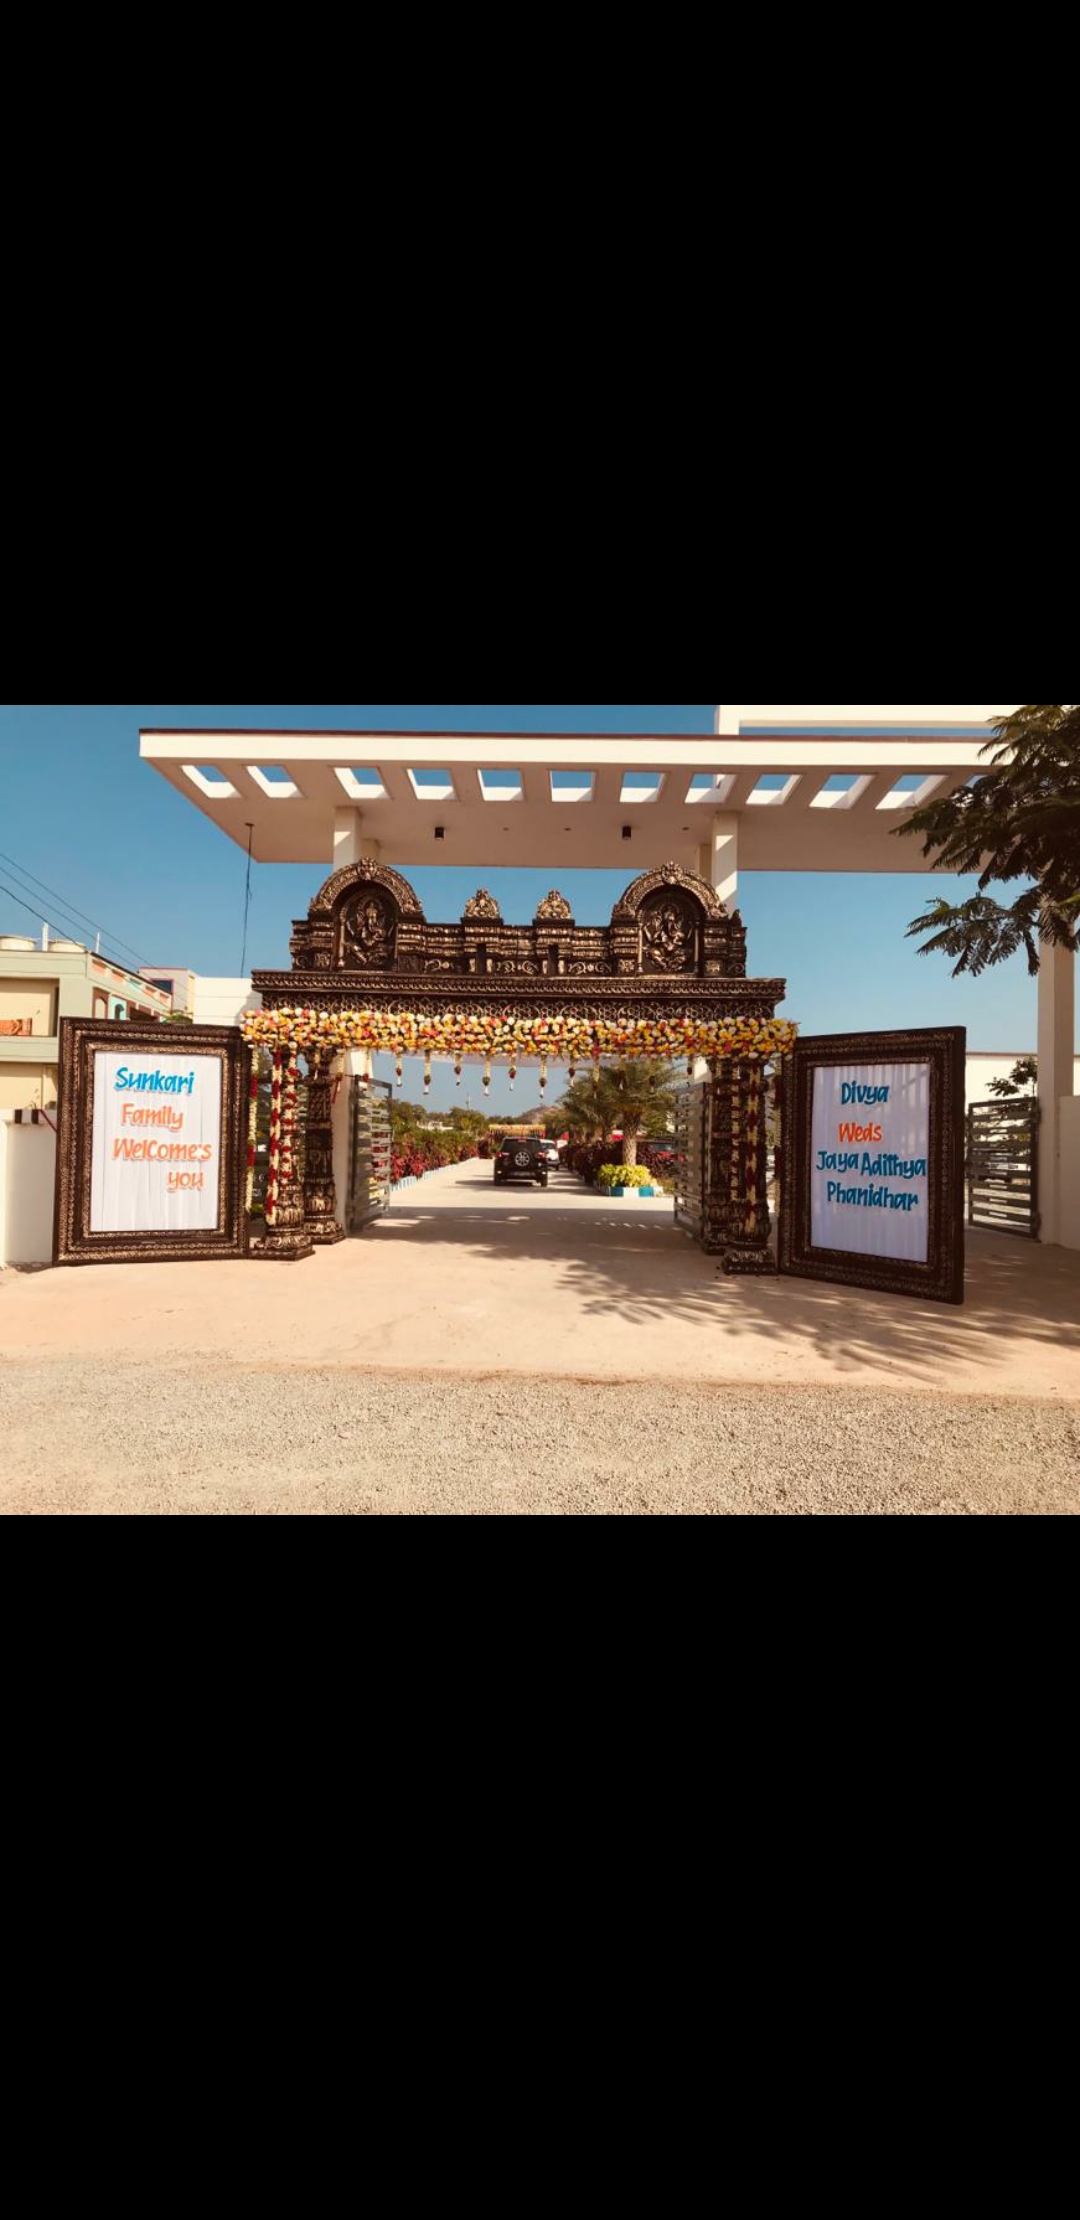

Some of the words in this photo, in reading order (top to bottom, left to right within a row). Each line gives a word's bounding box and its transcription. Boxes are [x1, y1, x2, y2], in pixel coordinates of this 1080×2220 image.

[115, 1067, 195, 1094] Sunkari
[841, 1081, 889, 1105] Divya
[121, 1102, 184, 1130] Family
[838, 1121, 882, 1143] Weds
[816, 1150, 859, 1174] Jaya
[167, 1171, 204, 1191] you
[827, 1181, 919, 1211] Phanidhar
